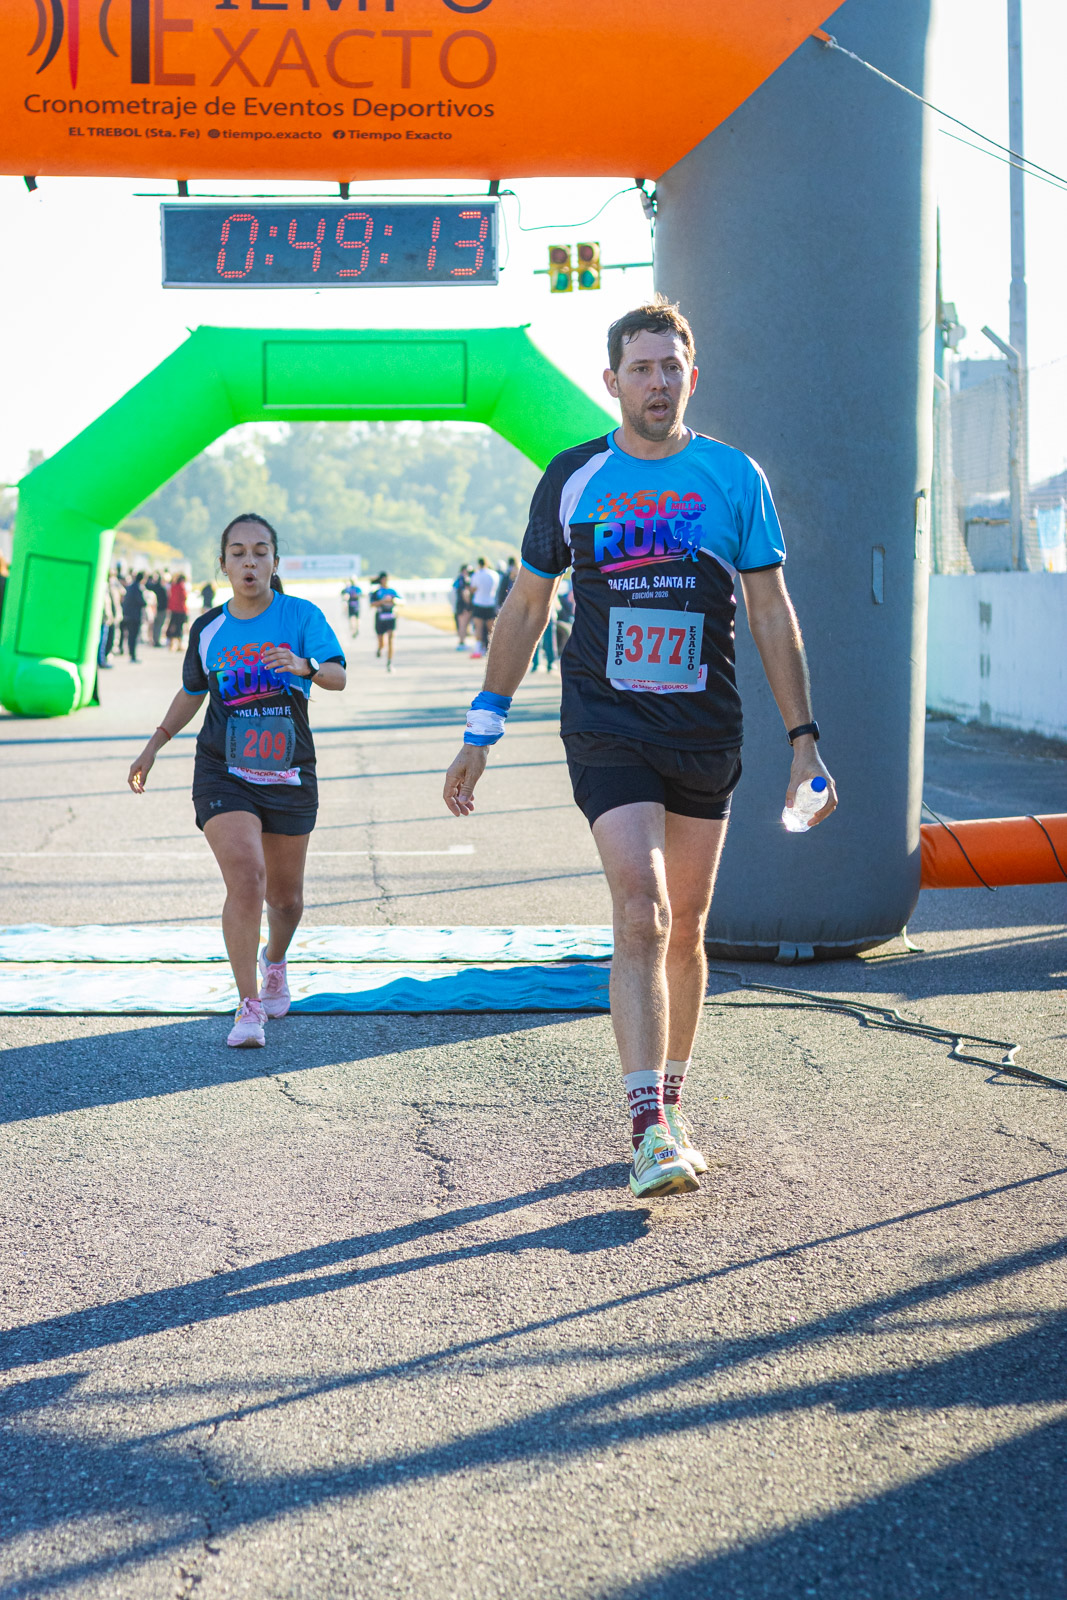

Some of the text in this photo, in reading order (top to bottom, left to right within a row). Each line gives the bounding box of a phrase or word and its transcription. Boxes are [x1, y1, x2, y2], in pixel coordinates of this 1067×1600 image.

[24, 94, 494, 121] Cronometraje de Eventos Deportivos
[69, 127, 200, 139] EL TREBOL (Sta. Fe)
[349, 129, 453, 141] Tiempo Exacto
[671, 502, 707, 512] MILLAS
[594, 519, 685, 562] RUN
[608, 575, 696, 590] RAFAELA, SANTA FE
[632, 591, 653, 600] EDICIÓN
[614, 621, 624, 666] TIEMPO
[624, 625, 686, 665] 377
[687, 625, 697, 671] EXACTO
[262, 706, 283, 716] SANTA
[285, 706, 291, 716] FE
[243, 728, 286, 761] 209
